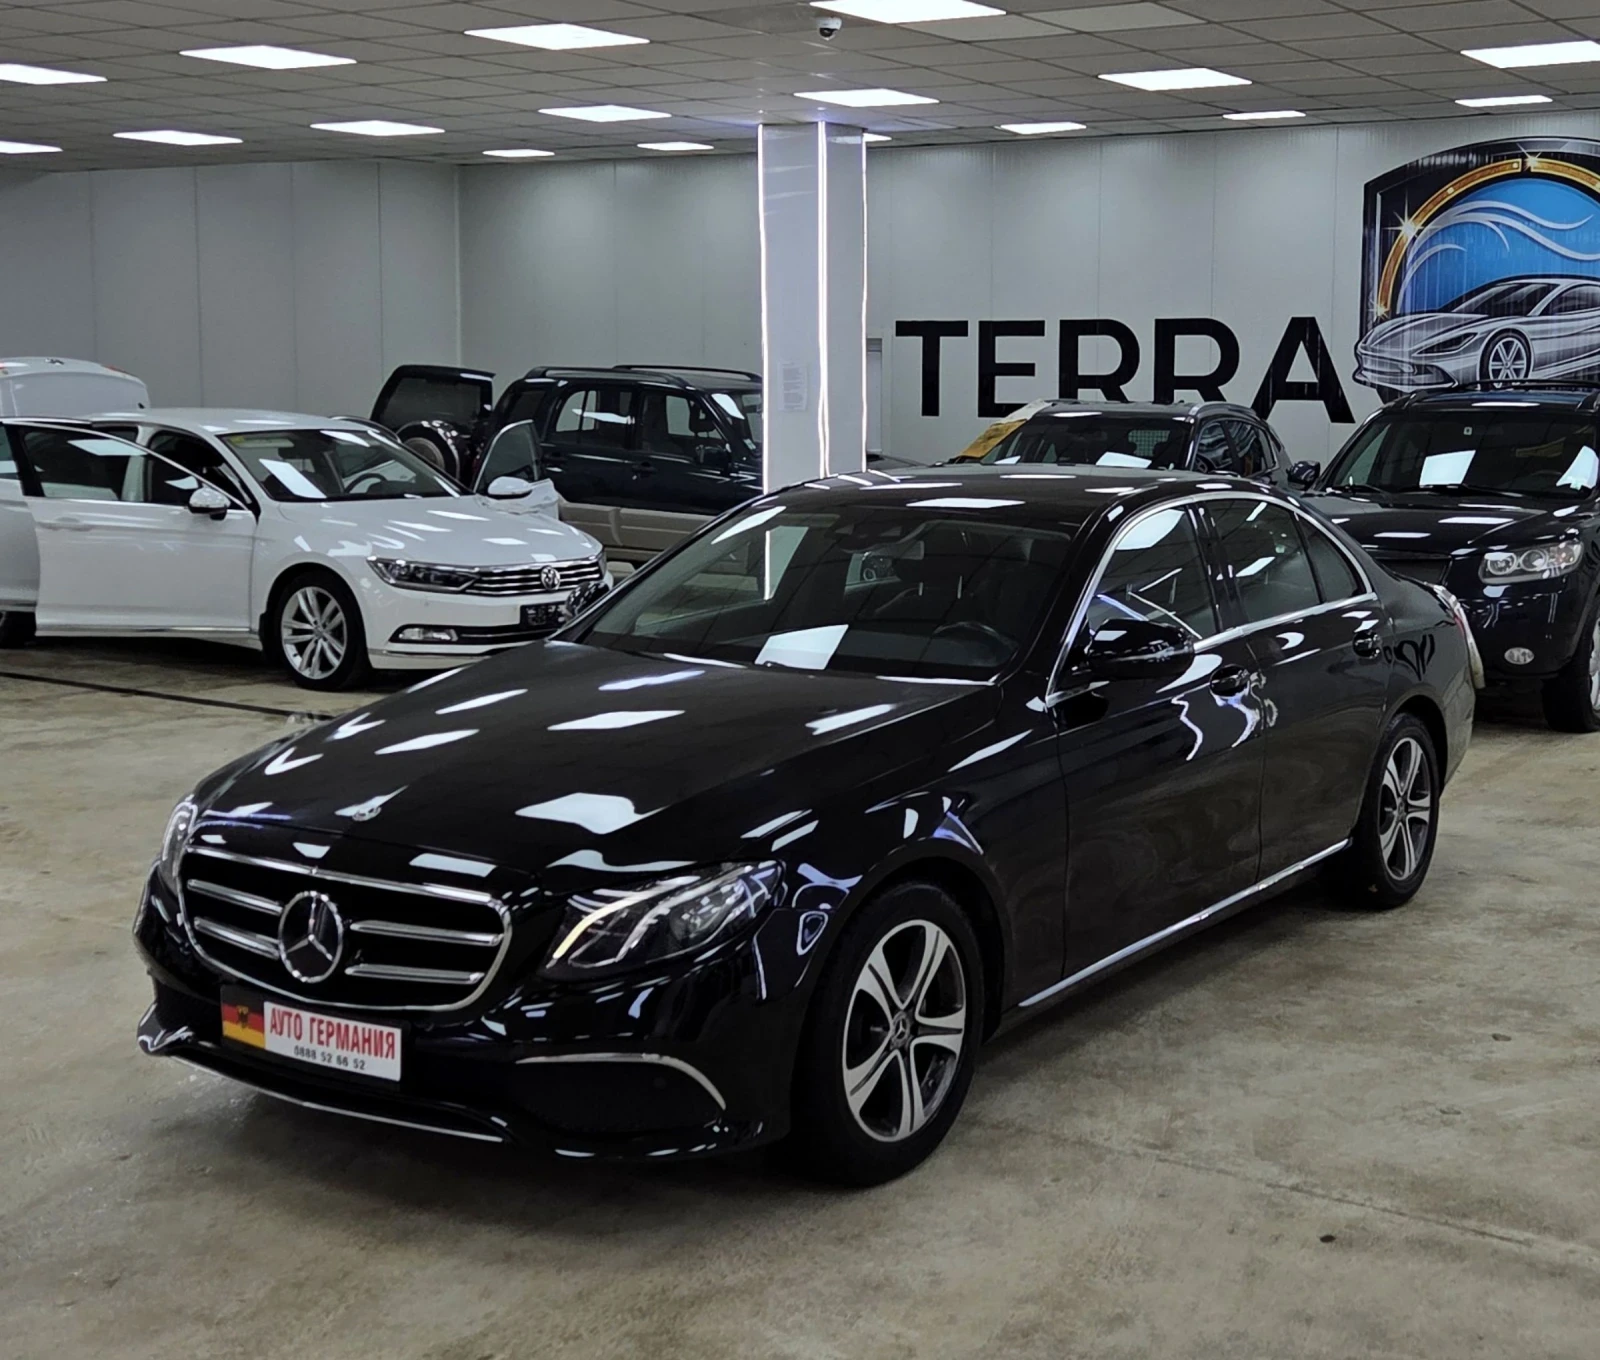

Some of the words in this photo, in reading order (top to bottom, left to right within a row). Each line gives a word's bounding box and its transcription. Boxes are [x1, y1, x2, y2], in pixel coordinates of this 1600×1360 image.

[895, 316, 1356, 424] TERRA
[270, 1007, 303, 1041] АУТО
[309, 1016, 395, 1060] ГЕРМАНИЯ
